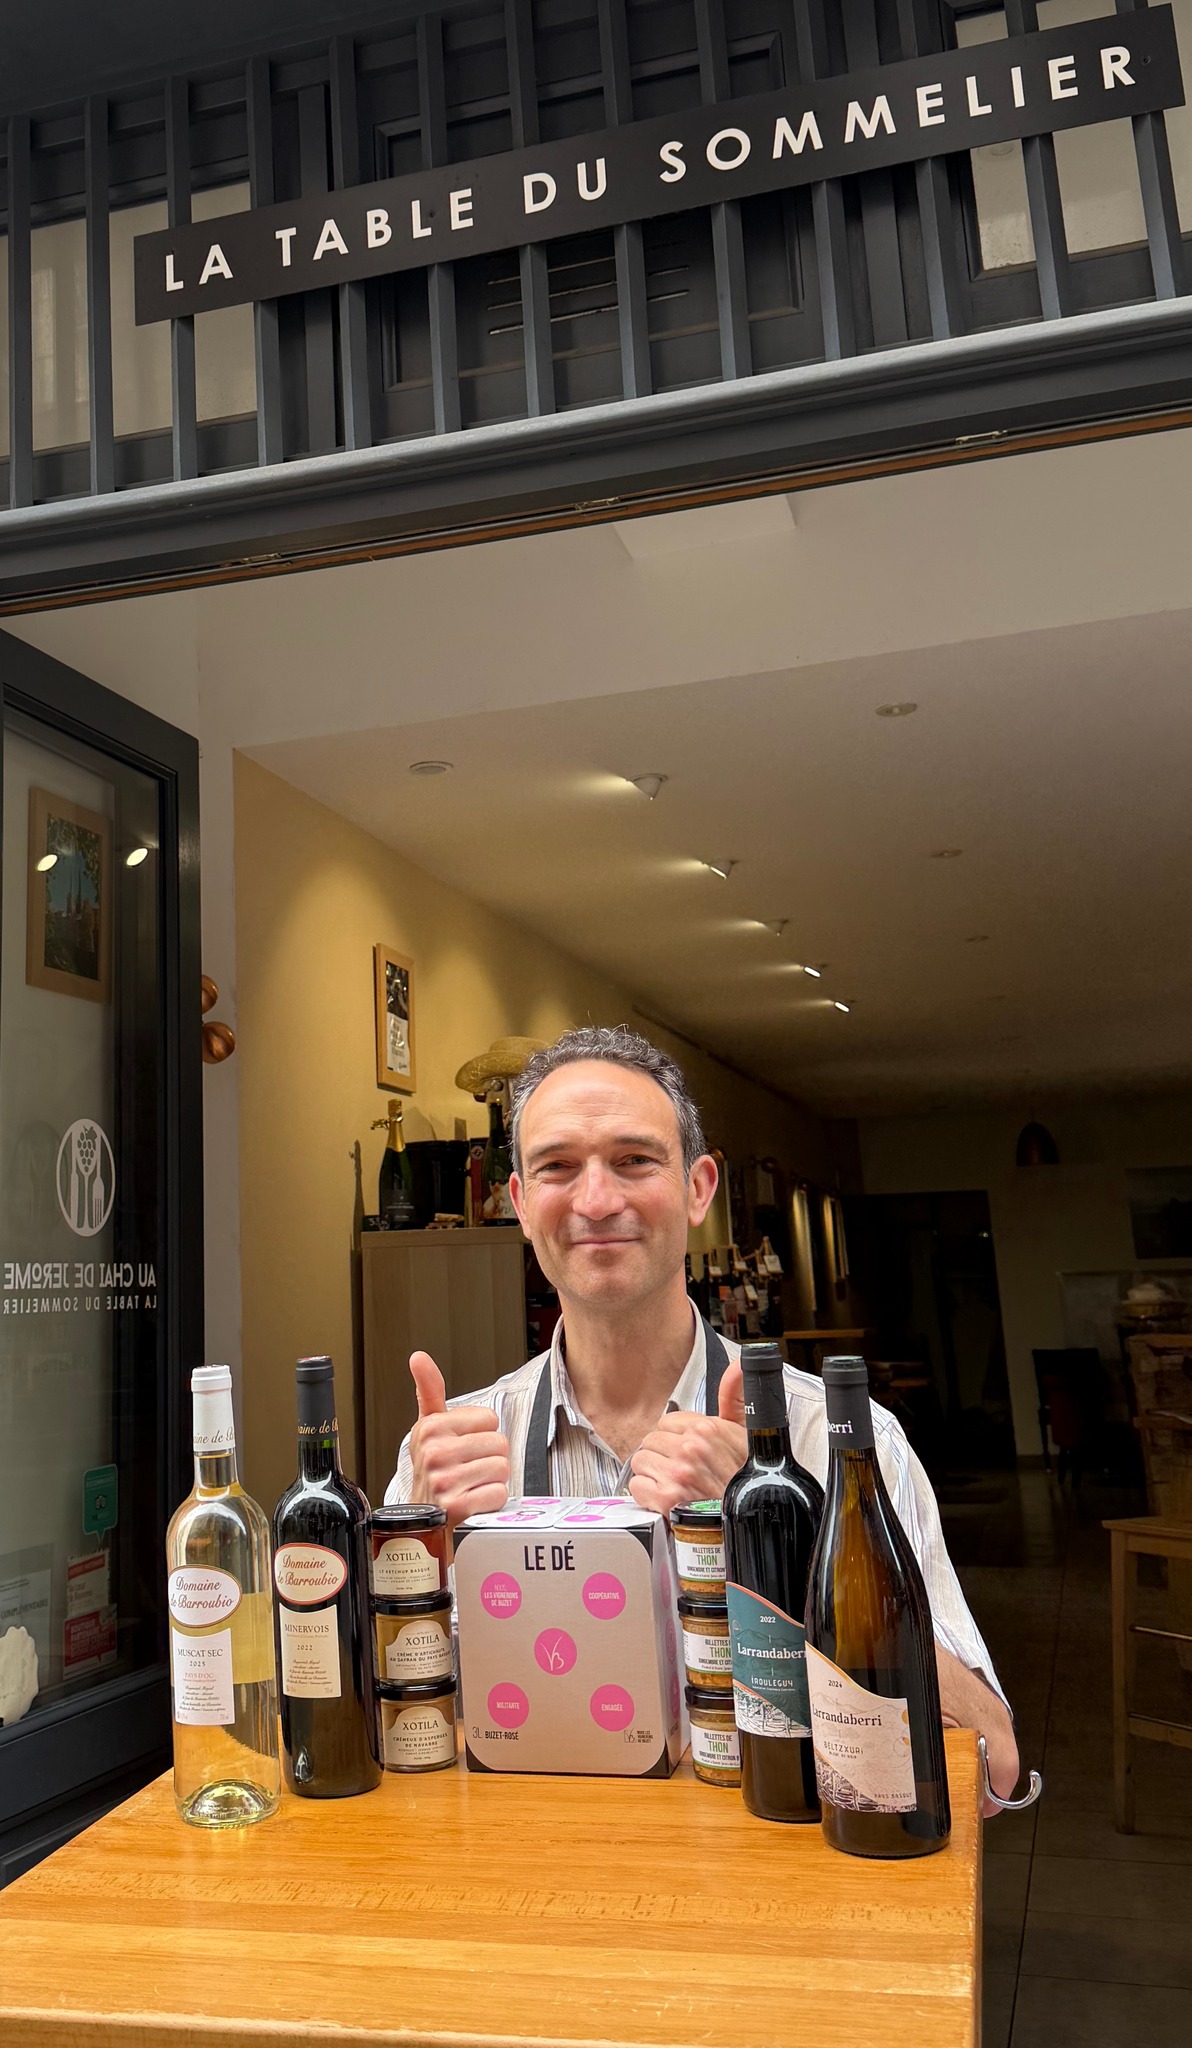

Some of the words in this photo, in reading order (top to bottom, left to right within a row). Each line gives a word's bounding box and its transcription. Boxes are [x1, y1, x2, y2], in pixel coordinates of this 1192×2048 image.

[165, 243, 234, 293] LA
[274, 187, 475, 267] TABLE
[522, 157, 608, 215] DU
[658, 45, 1136, 184] SOMMELIER
[318, 1419, 331, 1434] de
[211, 1429, 224, 1444] de
[282, 1554, 327, 1569] Domaine
[385, 1552, 422, 1562] XOTILA
[523, 1545, 546, 1571] LE
[551, 1540, 576, 1571] DÉ
[696, 1554, 718, 1566] THON
[175, 1575, 222, 1591] Domaine
[285, 1571, 339, 1587] Barroubio
[177, 1593, 234, 1609] Barroubio
[484, 1591, 493, 1599] LES
[491, 1599, 498, 1607] DE
[759, 1615, 776, 1624] 2022
[284, 1623, 330, 1634] MINERVOIS
[405, 1634, 440, 1646] XOTILA
[207, 1648, 224, 1658] SEC
[296, 1644, 313, 1652] 2022
[709, 1646, 732, 1658] THON
[737, 1642, 806, 1660] Larrandaber
[812, 1703, 882, 1727] Larrandaberri
[402, 1720, 439, 1731] XOTILA
[472, 1726, 483, 1739] 3L
[726, 1734, 732, 1742] DE
[707, 1740, 729, 1754] THON
